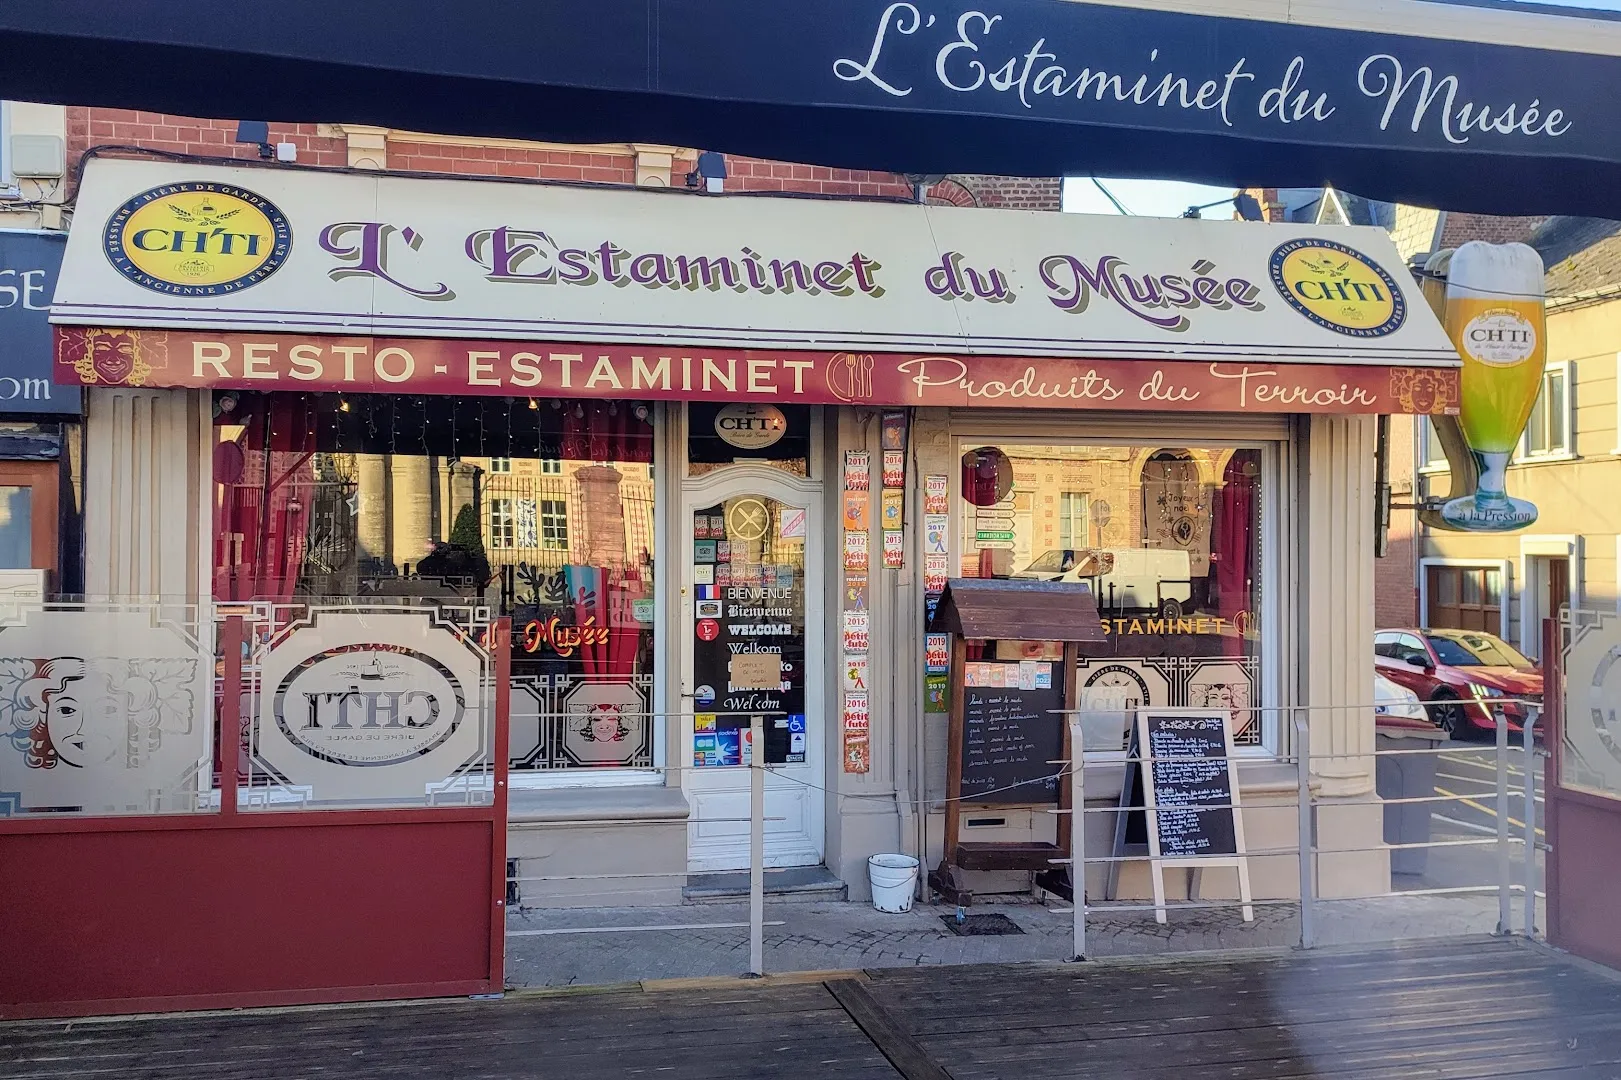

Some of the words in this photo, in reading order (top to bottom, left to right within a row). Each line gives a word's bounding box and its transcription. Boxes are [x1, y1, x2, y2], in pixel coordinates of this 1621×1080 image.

[1258, 56, 1336, 123] du
[1357, 54, 1573, 144] Musée
[143, 183, 189, 201] BIÈRE
[195, 183, 215, 192] DE
[221, 186, 267, 209] GARDE
[109, 208, 131, 253] BRASSÉE
[273, 216, 288, 240] FILS
[131, 227, 263, 257] CH'TI
[275, 243, 287, 257] EN
[1323, 241, 1364, 260] GARDE
[248, 259, 279, 283] PÈRE
[123, 265, 216, 295] L'ANCIENNE
[223, 281, 244, 292] DE
[924, 250, 1017, 304] du
[1038, 254, 1267, 333] Musée
[1294, 278, 1387, 302] CH'TI
[1381, 323, 1395, 333] DE
[191, 341, 416, 384] RESTO
[466, 350, 815, 395] ESTAMINET
[897, 356, 1125, 403] Produits
[1138, 370, 1201, 402] du
[1208, 362, 1377, 408] Terroir
[848, 457, 867, 466] 2011
[885, 456, 902, 464] 2014
[928, 482, 945, 490] 2017
[1470, 509, 1480, 521] la
[1484, 509, 1531, 521] Pression
[847, 537, 866, 546] 2012
[885, 536, 902, 544] 2013
[928, 561, 946, 569] 2018
[728, 587, 792, 599] BIENVENUE
[728, 604, 793, 617] Bienvenue
[847, 617, 866, 625] 2015
[1100, 617, 1226, 635] STAMINET
[523, 615, 610, 658] Musée
[727, 624, 792, 636] WELCOME
[727, 642, 783, 654] Welkom
[928, 637, 946, 646] 2019
[846, 699, 867, 708] 2016
